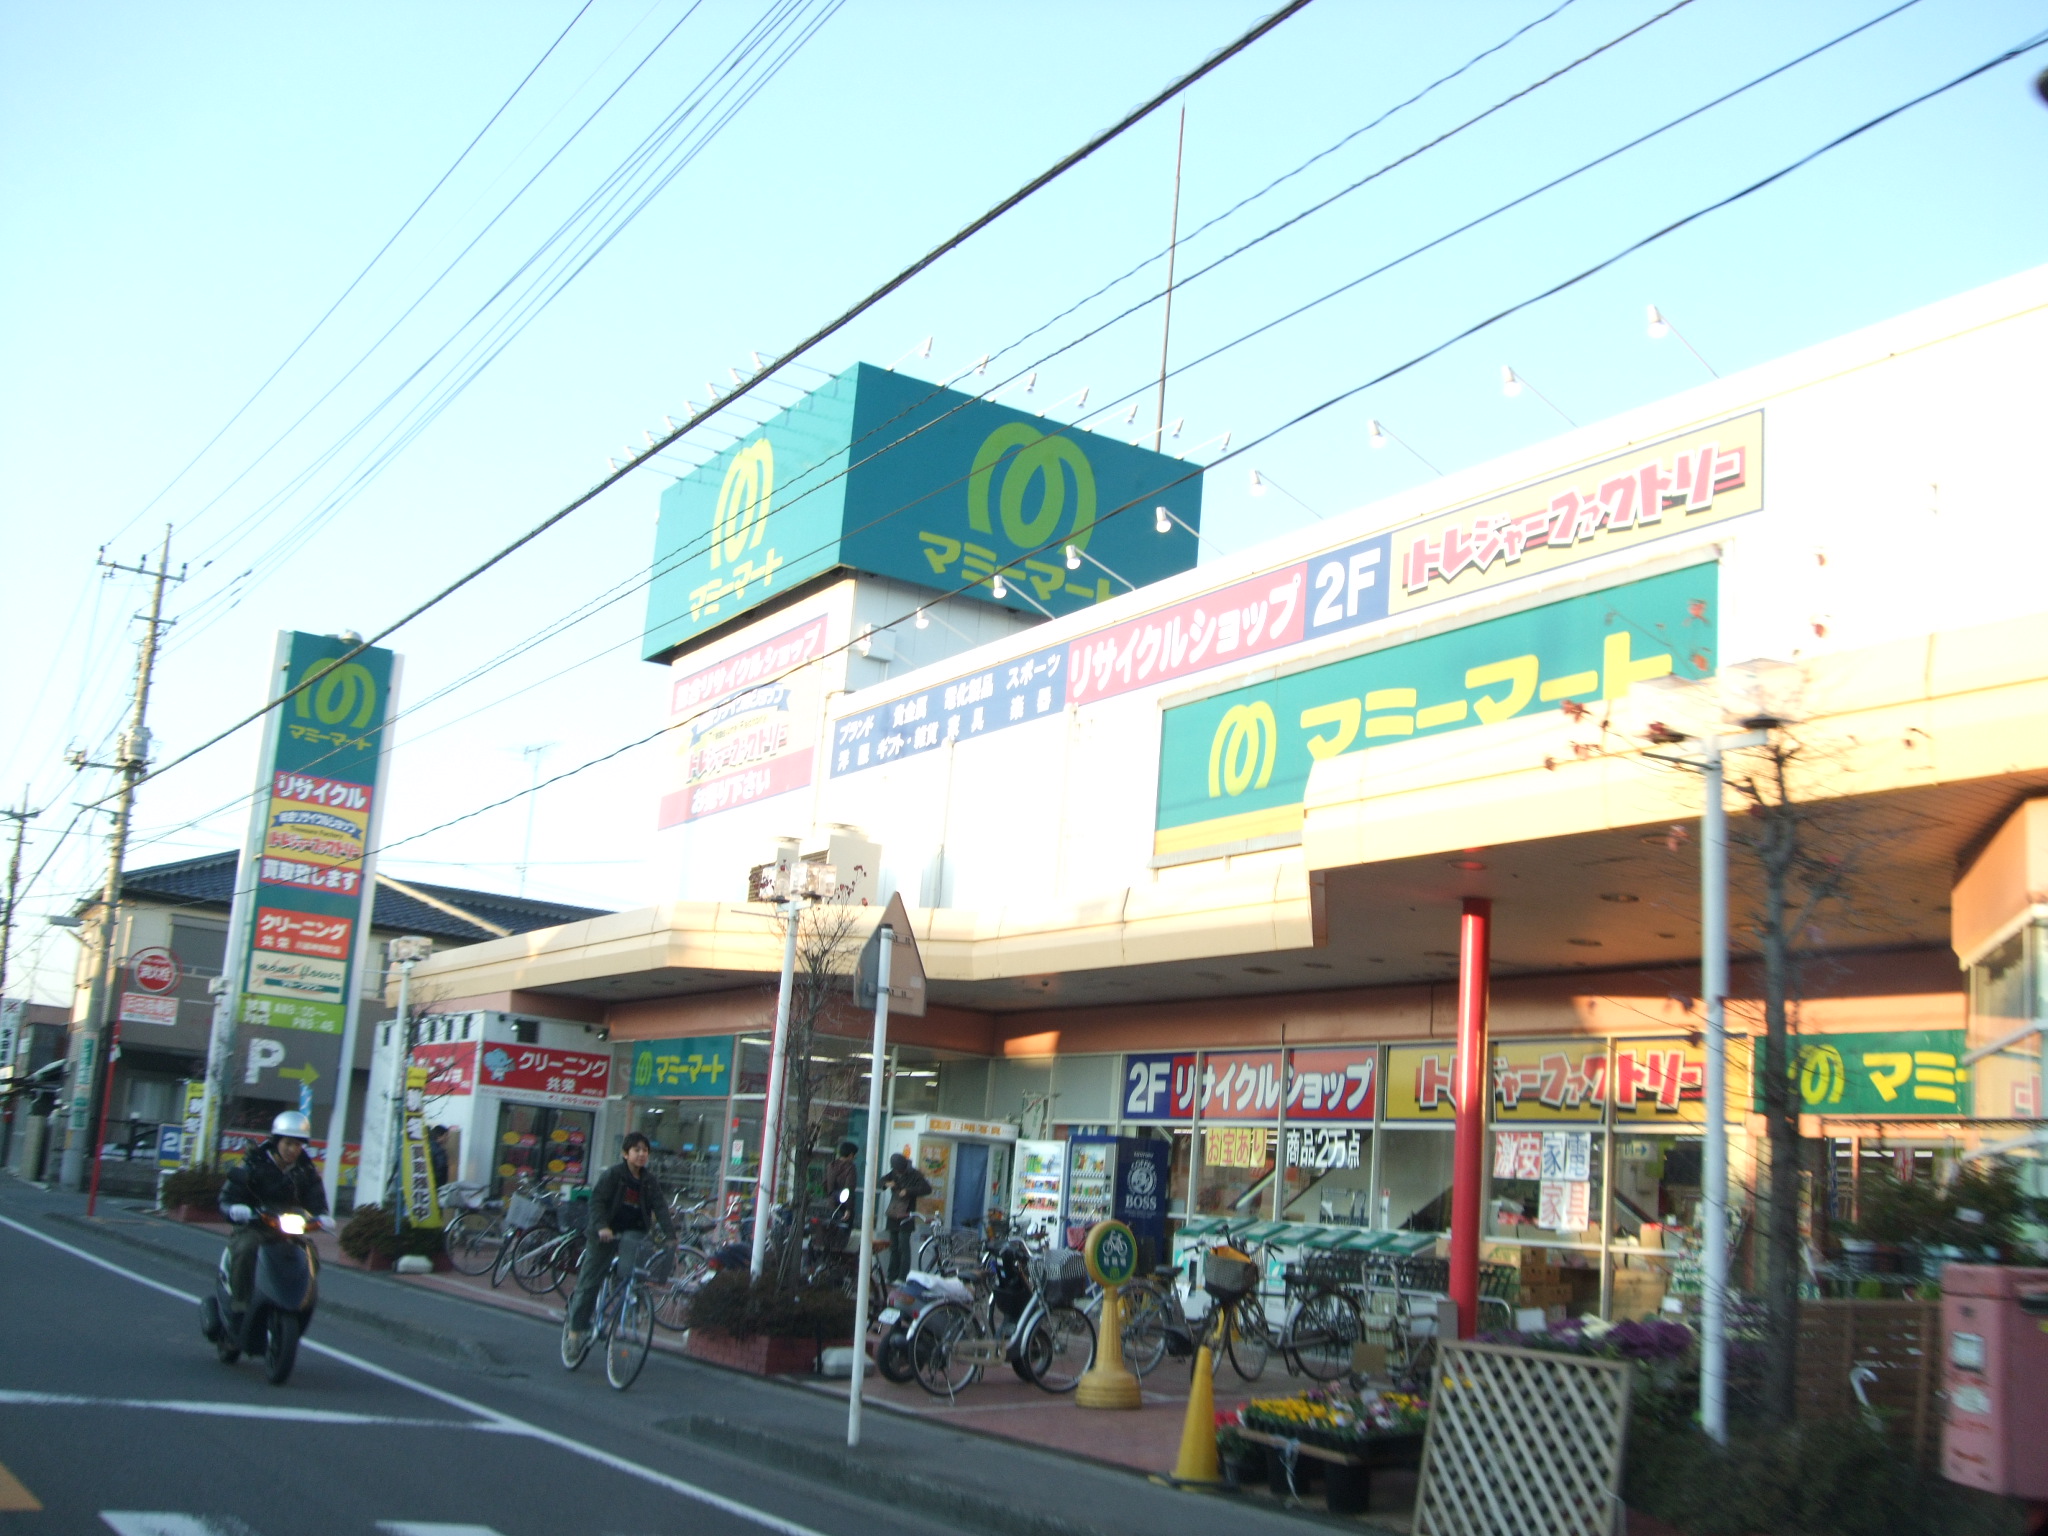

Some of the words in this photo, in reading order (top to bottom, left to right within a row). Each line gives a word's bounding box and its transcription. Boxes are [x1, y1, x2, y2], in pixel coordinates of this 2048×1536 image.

[1403, 443, 1745, 595] トレジャーファクトリー
[688, 548, 783, 623] マミーマート
[919, 530, 1115, 604] マミーマート
[1312, 548, 1381, 628] 2F
[1070, 573, 1302, 699] リサイクルショップ
[839, 714, 875, 745] ブランド
[1006, 654, 1061, 690] スポーツ
[1300, 631, 1673, 761] マミーマート
[288, 724, 372, 751] マミーマート
[278, 774, 367, 810] リサイクル
[260, 913, 348, 941] クリーニング
[244, 1037, 286, 1084] P
[518, 1050, 609, 1079] クリーニング
[656, 1053, 725, 1086] マミーマート
[1176, 1056, 1373, 1112] リサイクルショップ
[1416, 1050, 1706, 1112] トャーファクトリー
[1127, 1061, 1171, 1113] 2F
[1207, 1129, 1266, 1165] お宝あり
[1286, 1128, 1360, 1168] 商品2万点
[1125, 1194, 1157, 1211] BOSS
[1542, 1182, 1588, 1226] 家具
